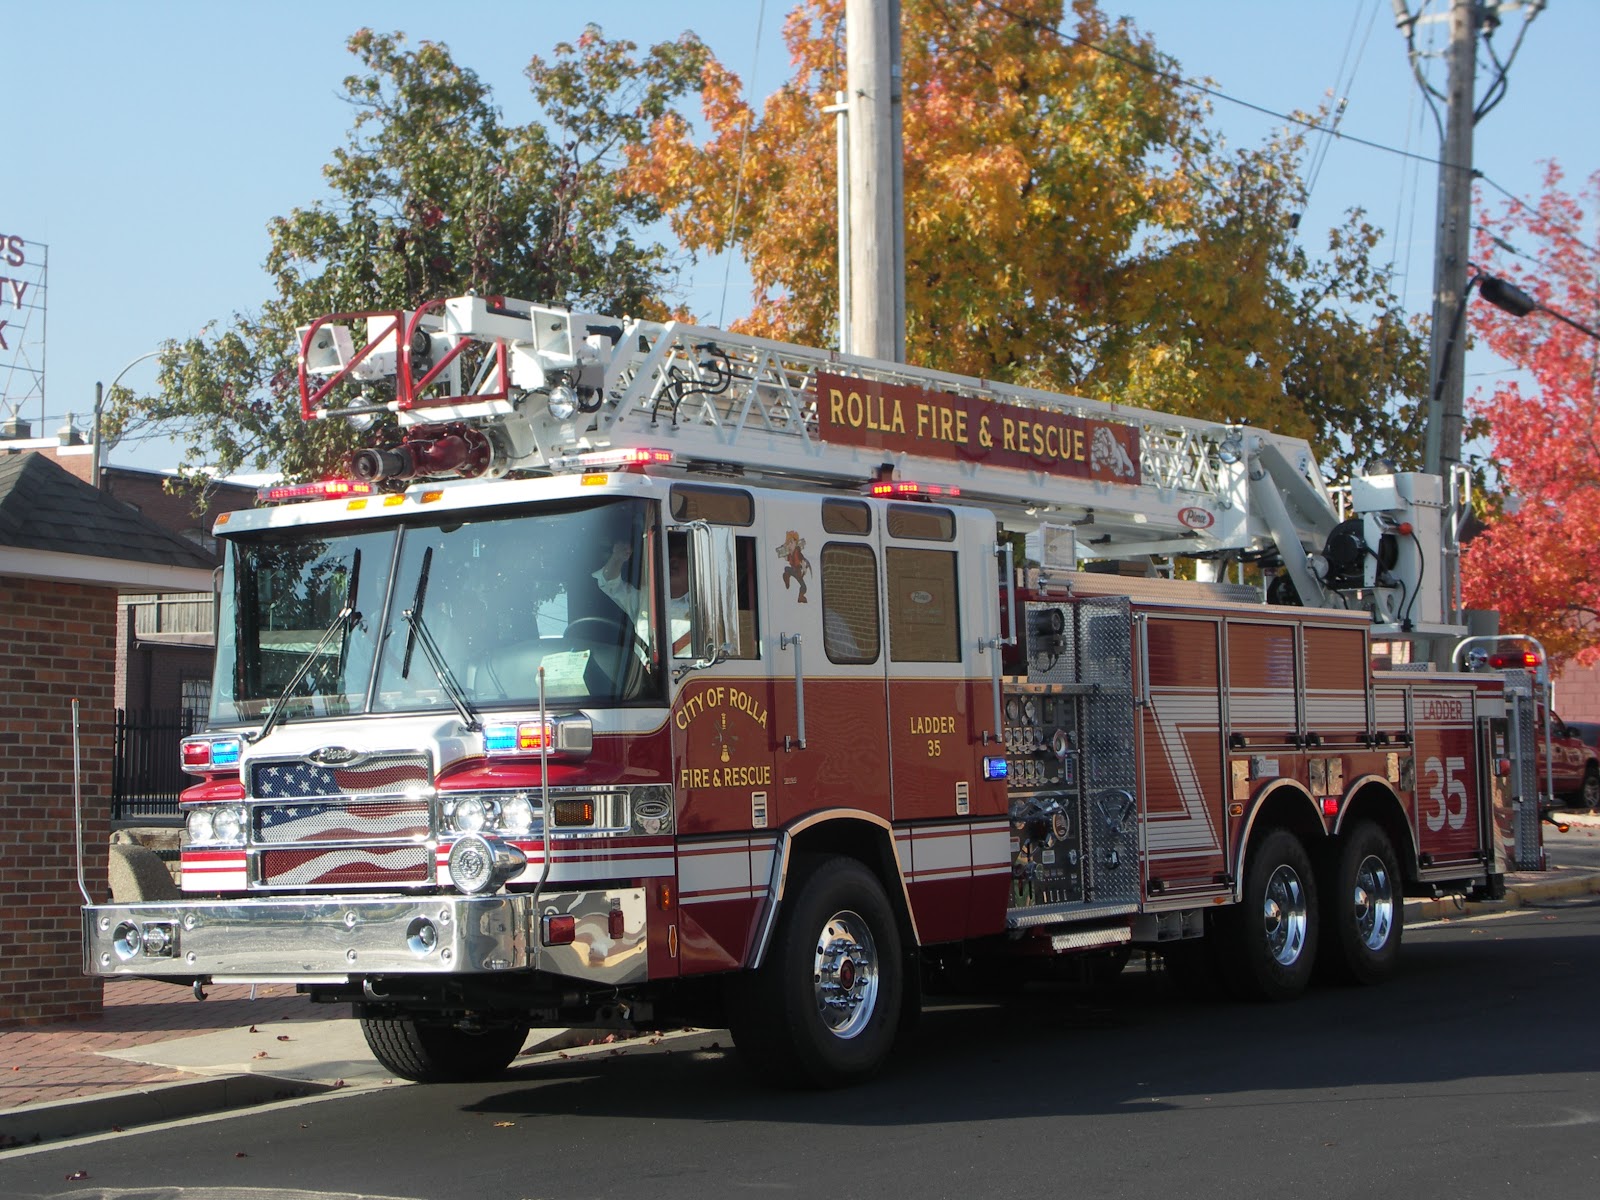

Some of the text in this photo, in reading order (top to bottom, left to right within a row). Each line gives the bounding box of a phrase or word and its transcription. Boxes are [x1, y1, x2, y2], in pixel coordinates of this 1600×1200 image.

[829, 388, 1086, 462] ROLLA FIRE & RESCUE
[675, 687, 769, 730] CITY OF ROLLA
[1422, 700, 1463, 721] LADDER
[910, 716, 956, 734] LADDER
[315, 746, 352, 763] Pierce
[927, 739, 941, 757] 35
[681, 769, 711, 789] FIRE
[712, 768, 722, 788] &
[724, 766, 772, 787] RESCUE
[1424, 756, 1468, 832] 35
